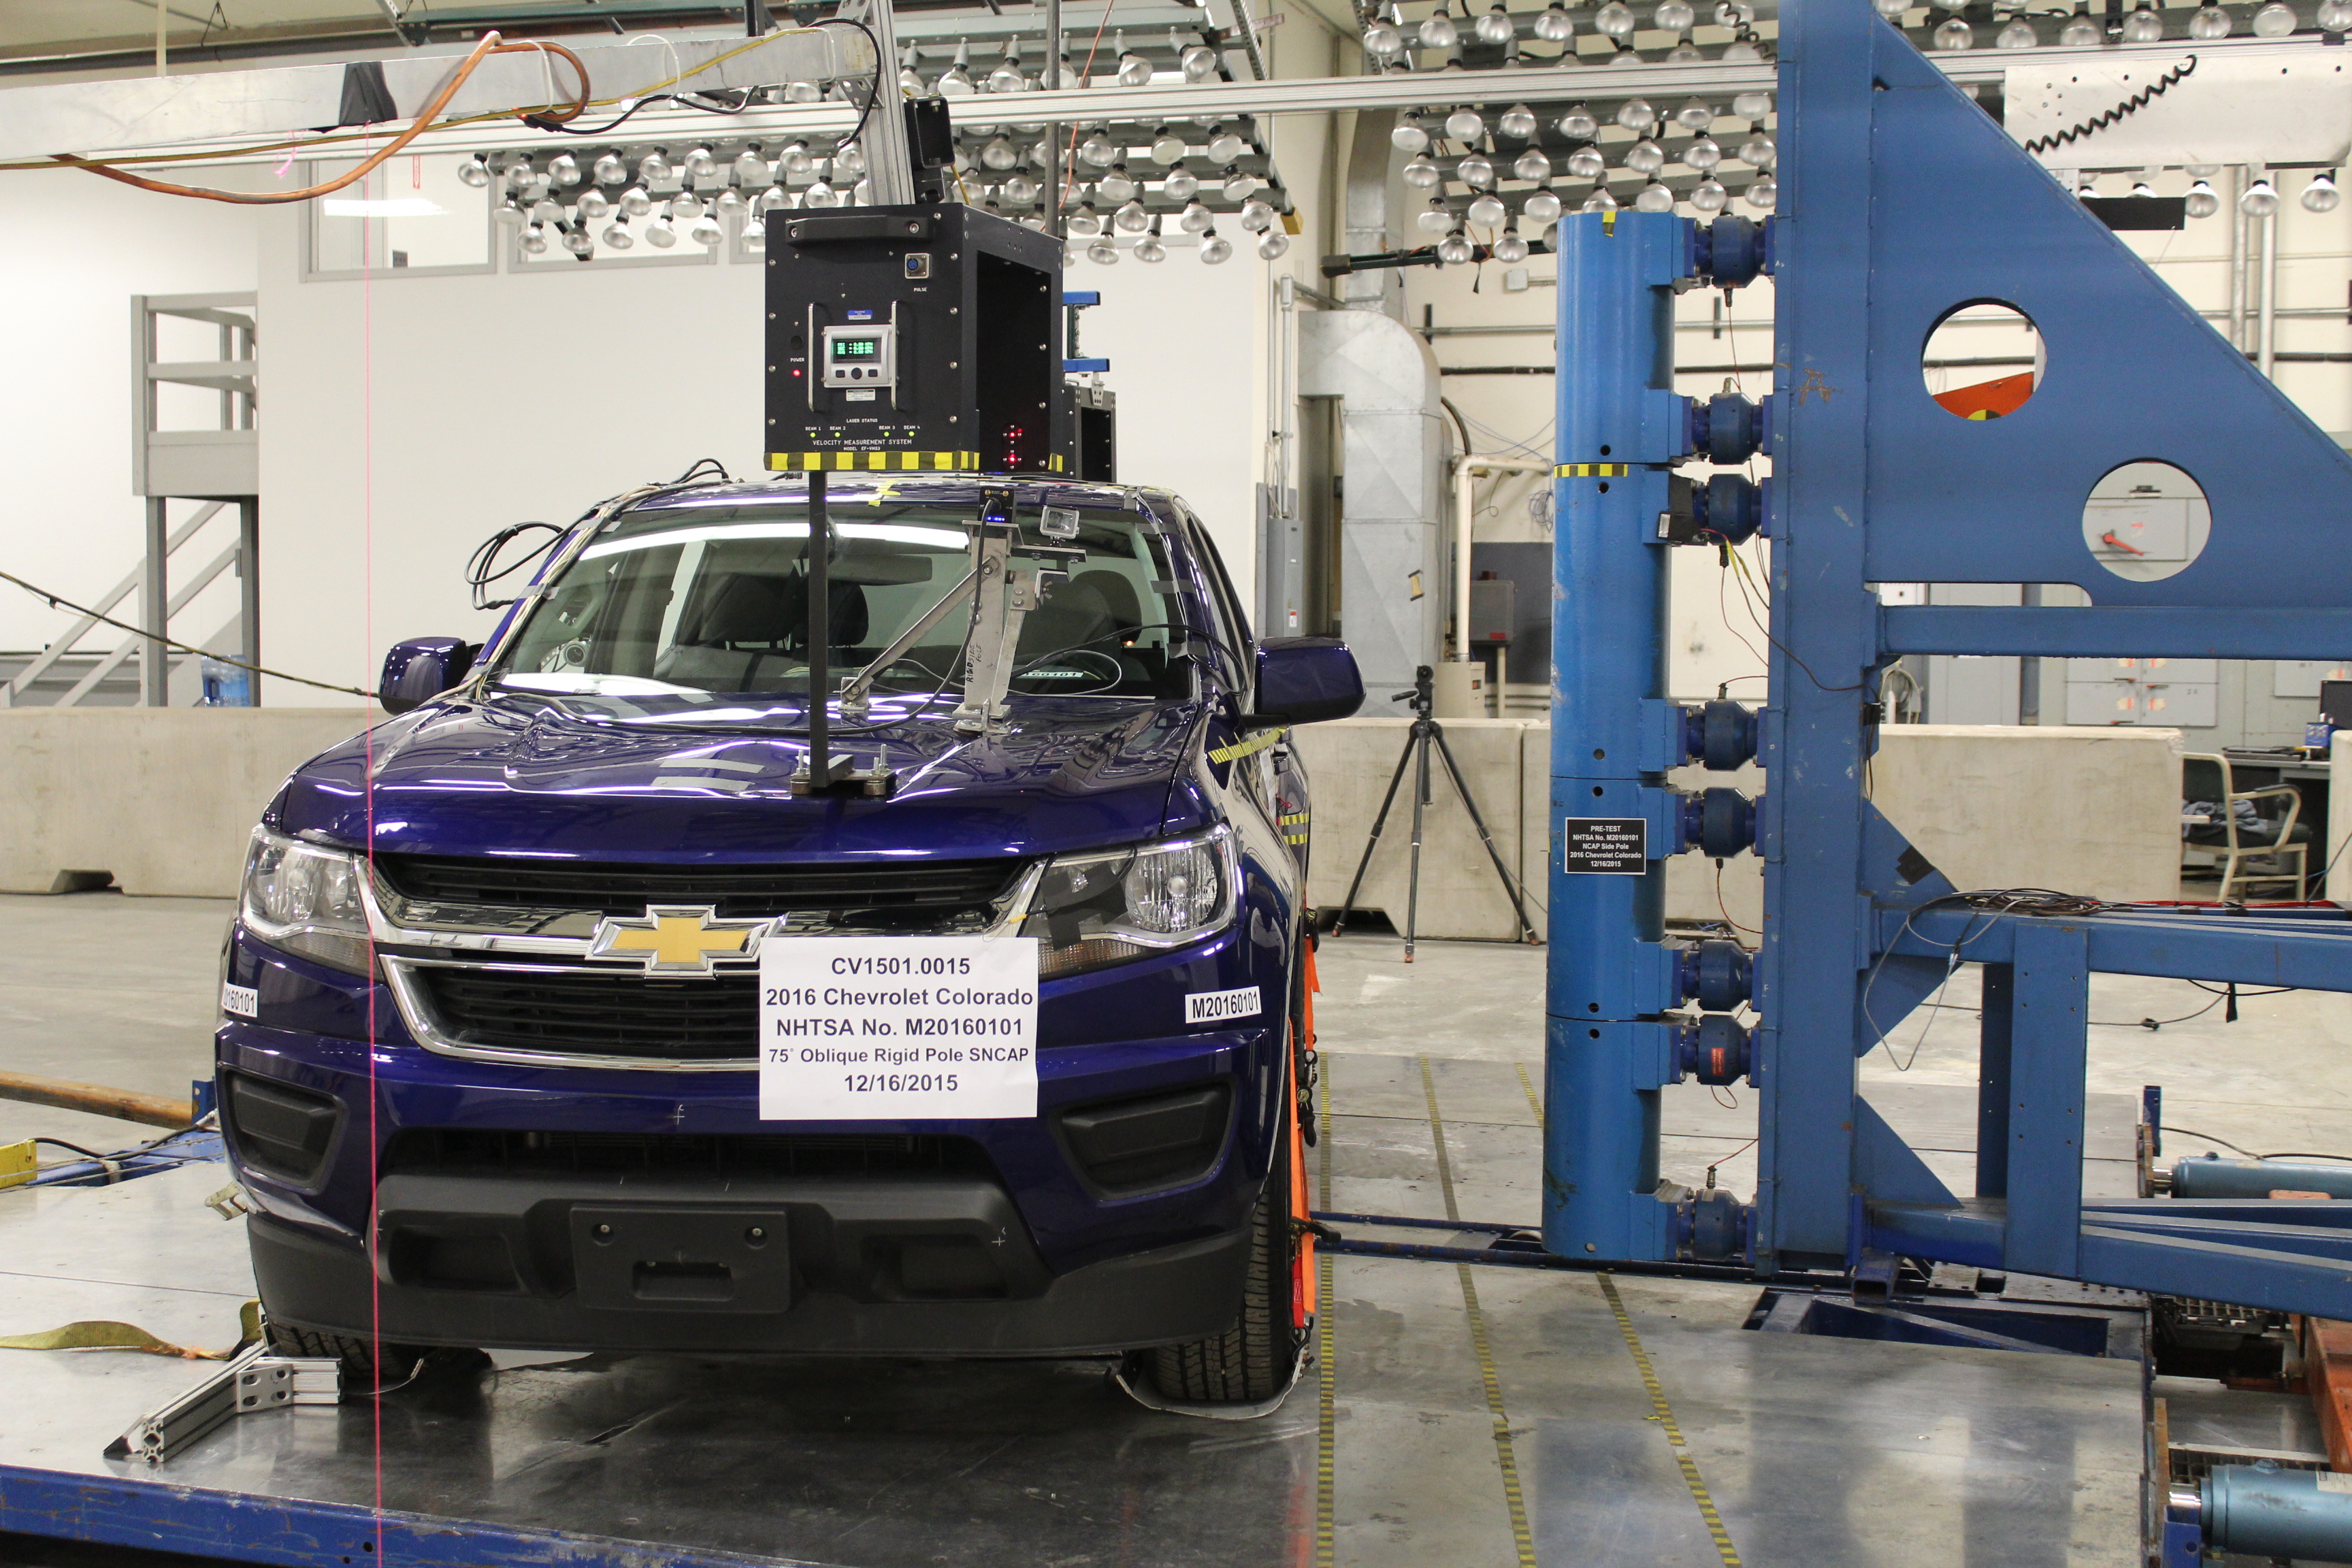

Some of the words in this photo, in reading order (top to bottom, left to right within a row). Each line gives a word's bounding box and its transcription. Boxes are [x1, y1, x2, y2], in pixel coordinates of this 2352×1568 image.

[832, 958, 970, 974] CV1501.0015
[225, 987, 255, 1013] 160101
[767, 989, 815, 1005] 2016
[824, 989, 928, 1004] Chevrolet
[936, 988, 1032, 1004] Colorado
[1192, 991, 1258, 1019] M20160101
[778, 1019, 854, 1035] NHTSA
[863, 1019, 896, 1035] No.
[906, 1019, 1020, 1035] M20160101
[801, 1049, 868, 1065] Oblique
[875, 1049, 918, 1065] Rigid
[926, 1049, 962, 1061] Pole
[970, 1048, 1028, 1061] SNCAP
[845, 1075, 958, 1091] 12/16/2015
